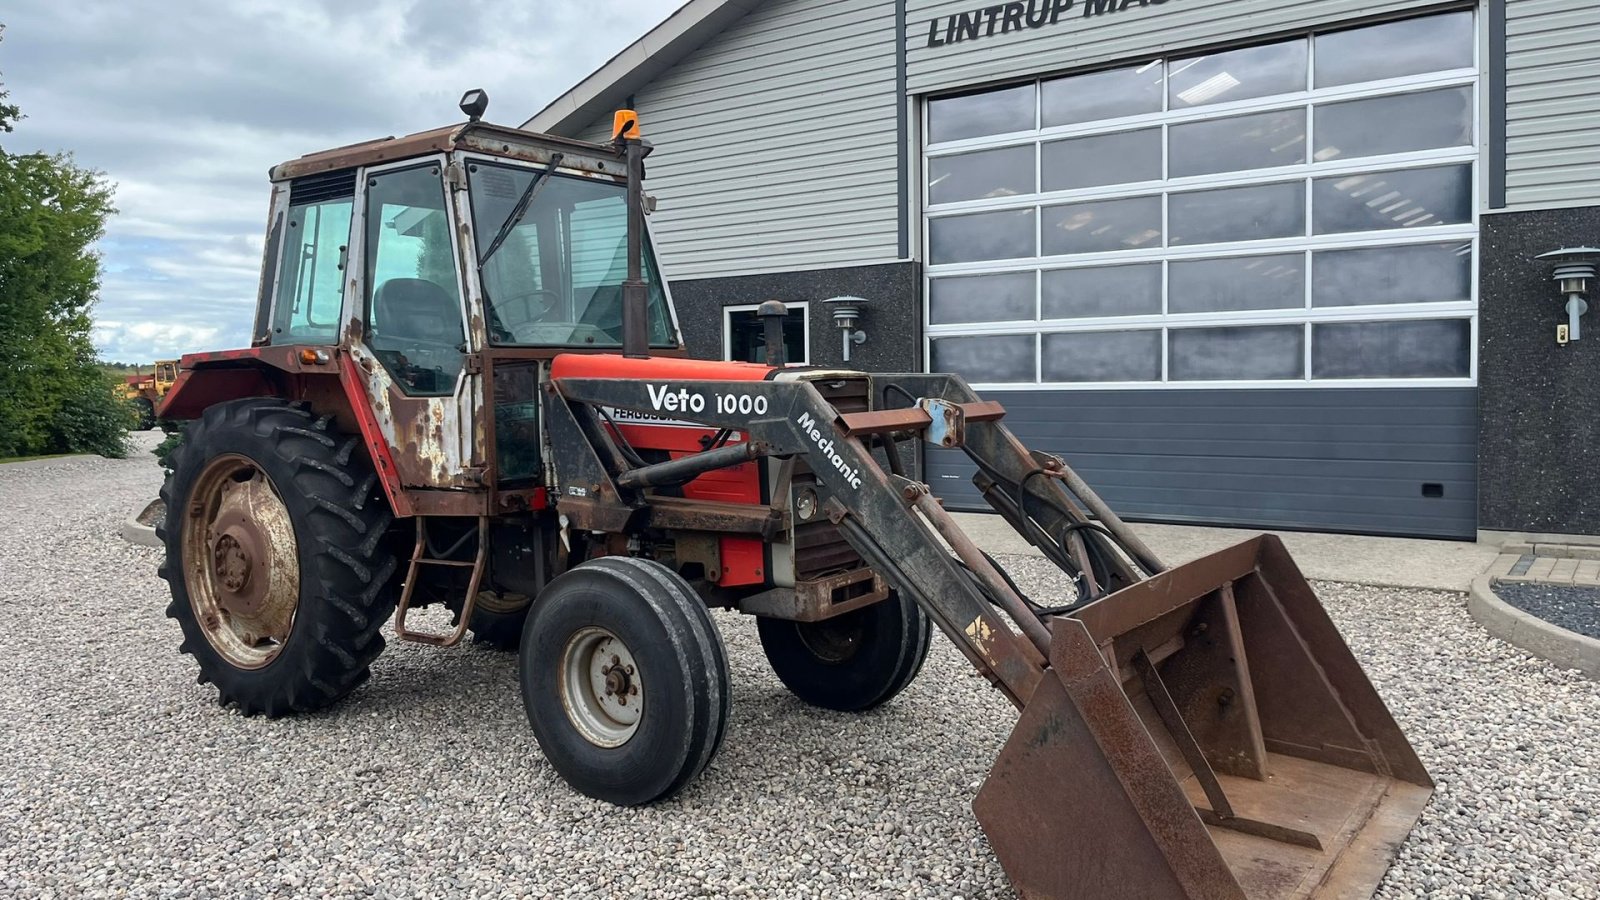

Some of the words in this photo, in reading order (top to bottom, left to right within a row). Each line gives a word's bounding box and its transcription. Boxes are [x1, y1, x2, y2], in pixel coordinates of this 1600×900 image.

[928, 0, 1074, 48] LINTRUP
[613, 407, 674, 421] FERGU
[647, 384, 705, 413] Veto
[716, 393, 768, 415] 1000
[797, 411, 863, 490] Mechanic
